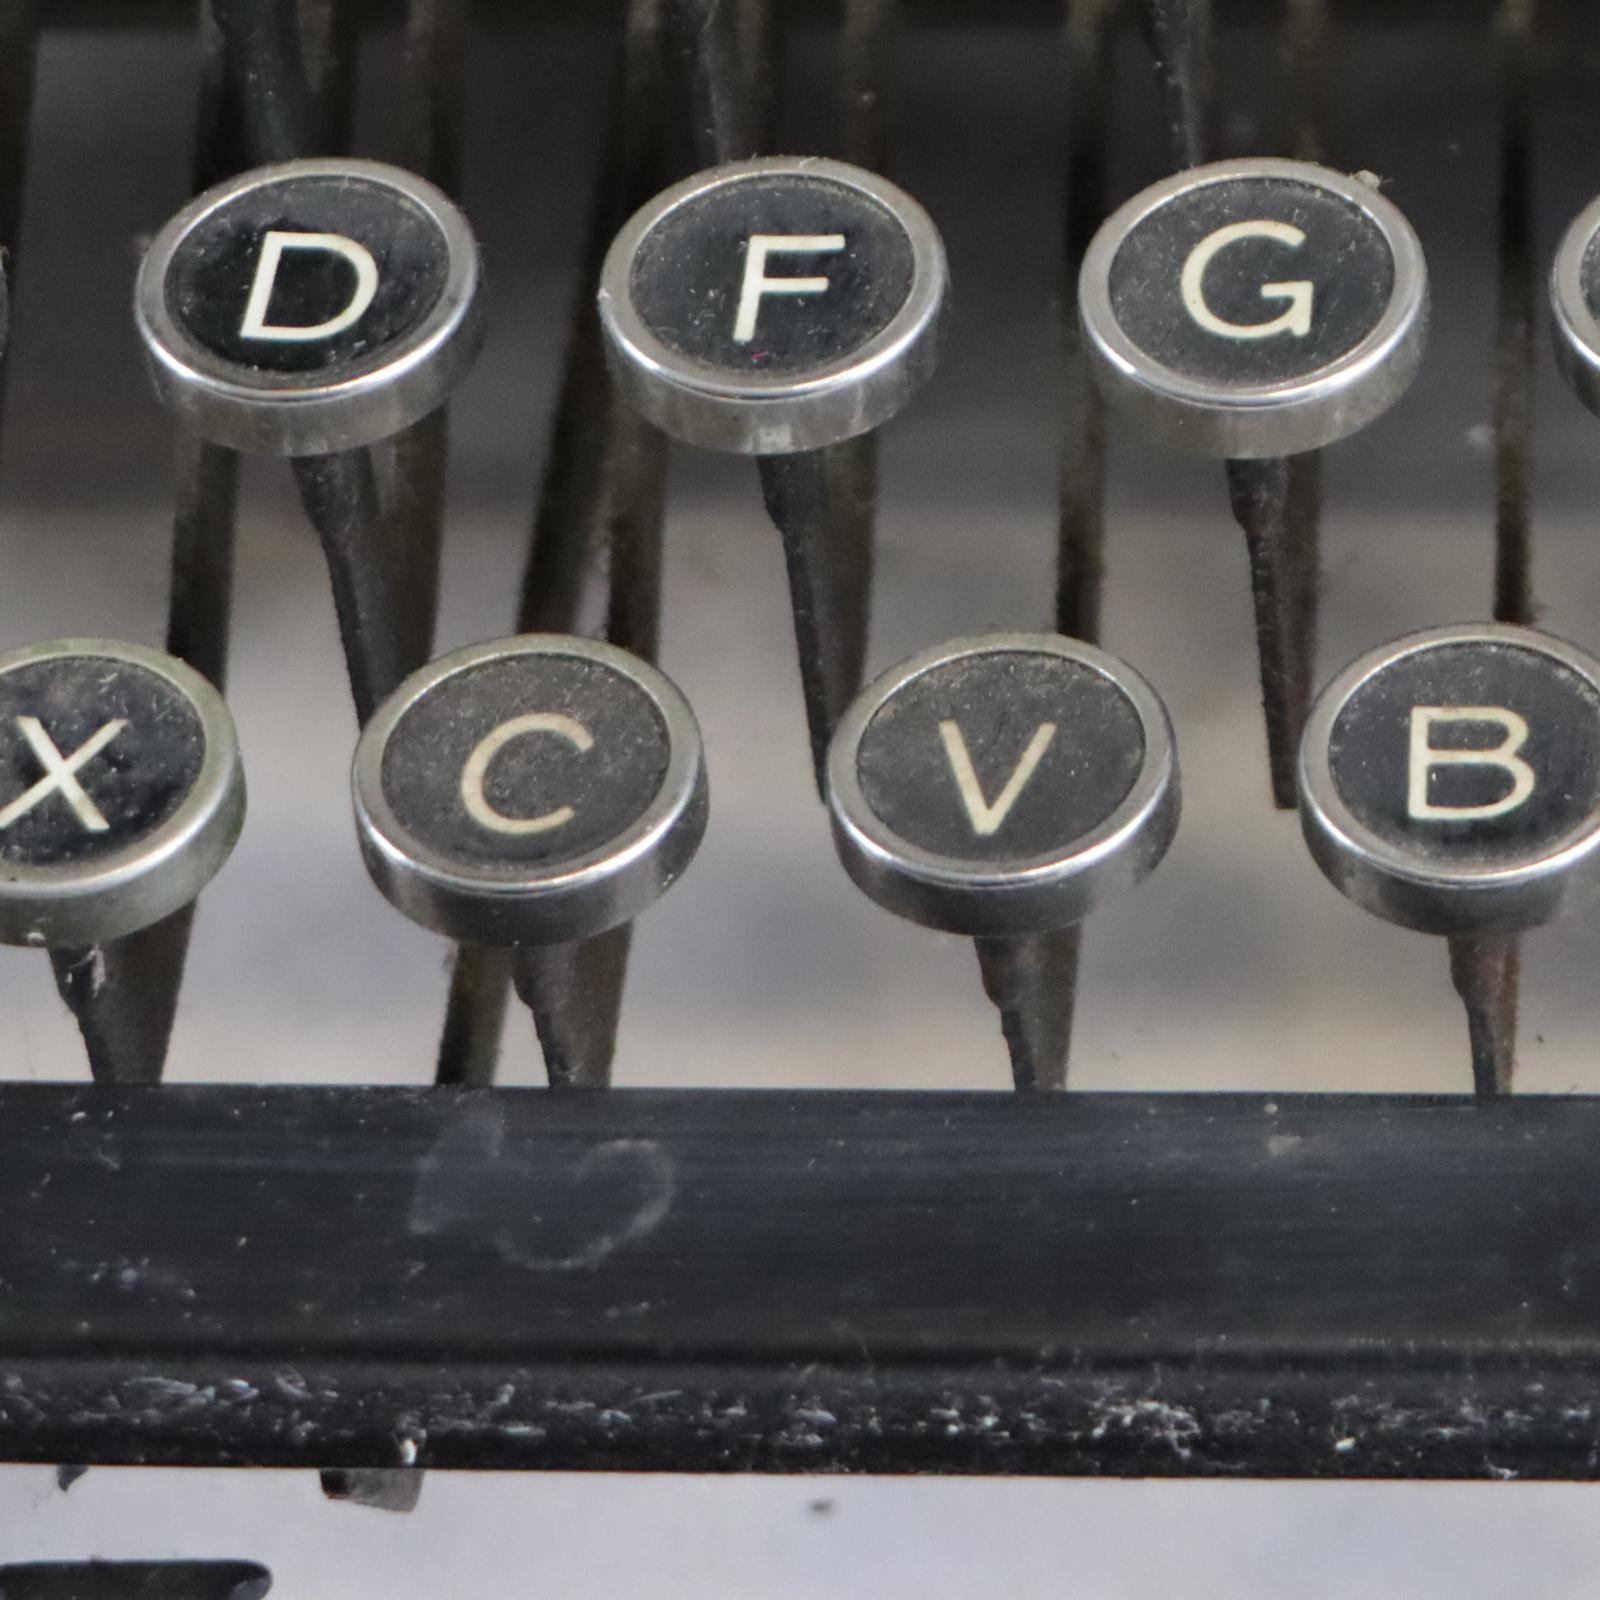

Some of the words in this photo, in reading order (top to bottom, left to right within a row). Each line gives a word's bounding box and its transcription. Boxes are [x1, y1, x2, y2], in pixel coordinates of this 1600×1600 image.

[238, 229, 380, 342] D
[732, 233, 847, 346] F
[1179, 219, 1315, 341] G
[0, 715, 130, 832] X
[459, 713, 593, 834] C
[937, 719, 1058, 836] V
[1406, 704, 1536, 822] B
